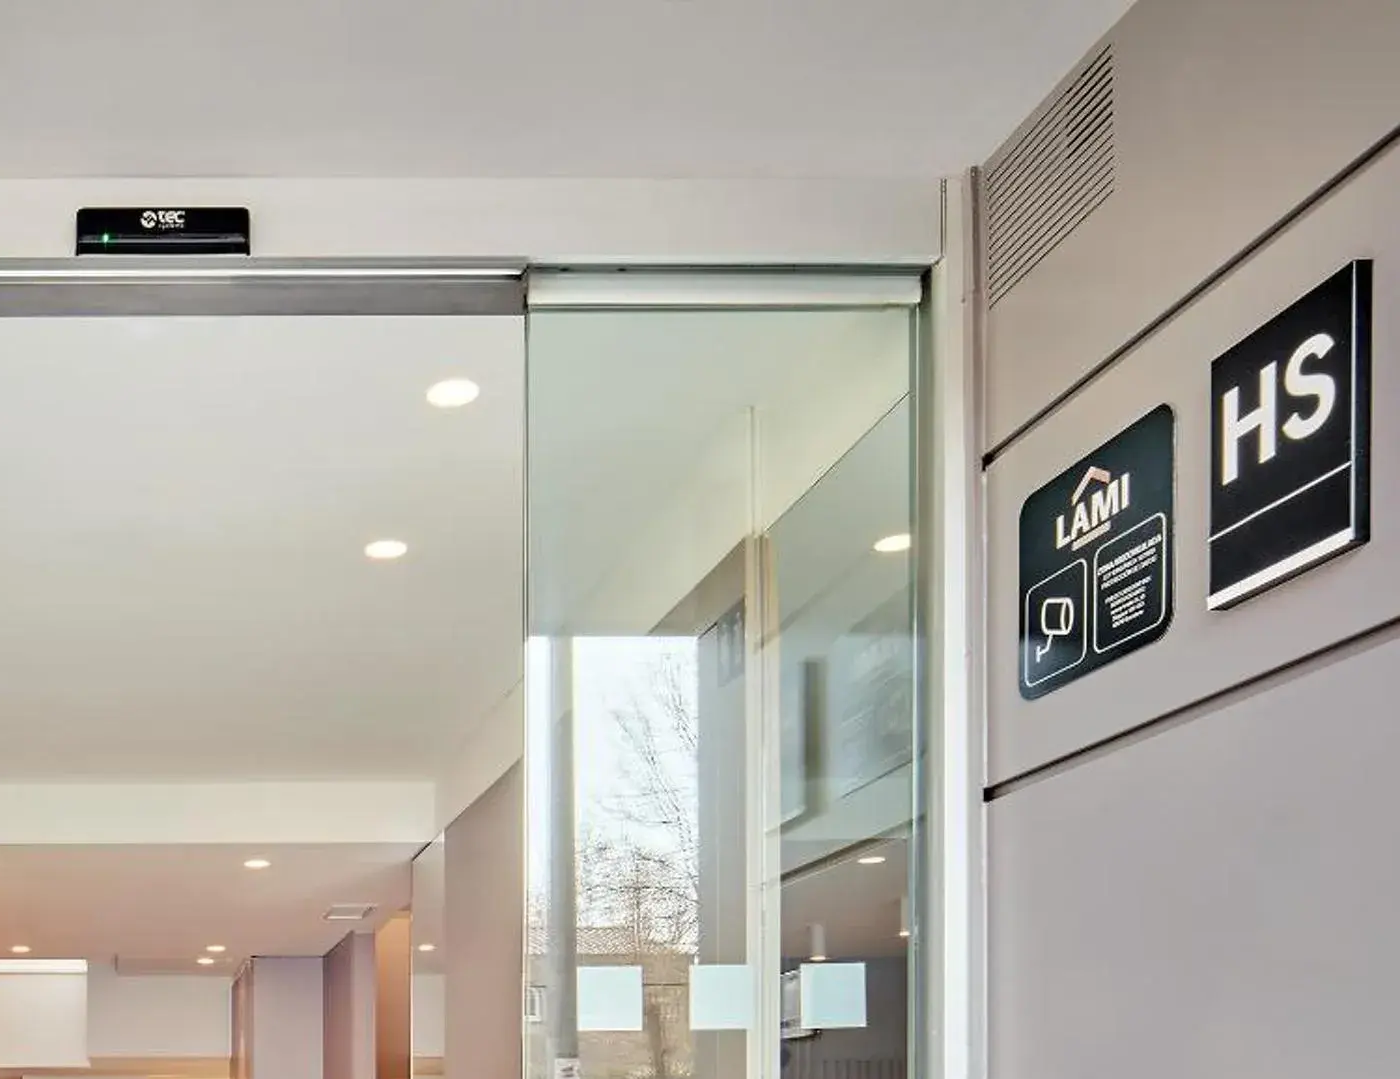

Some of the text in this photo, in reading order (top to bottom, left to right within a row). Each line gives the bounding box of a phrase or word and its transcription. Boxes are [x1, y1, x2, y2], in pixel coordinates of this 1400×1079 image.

[157, 210, 186, 223] tec
[1221, 333, 1336, 486] HS
[1055, 472, 1130, 550] LAMI
